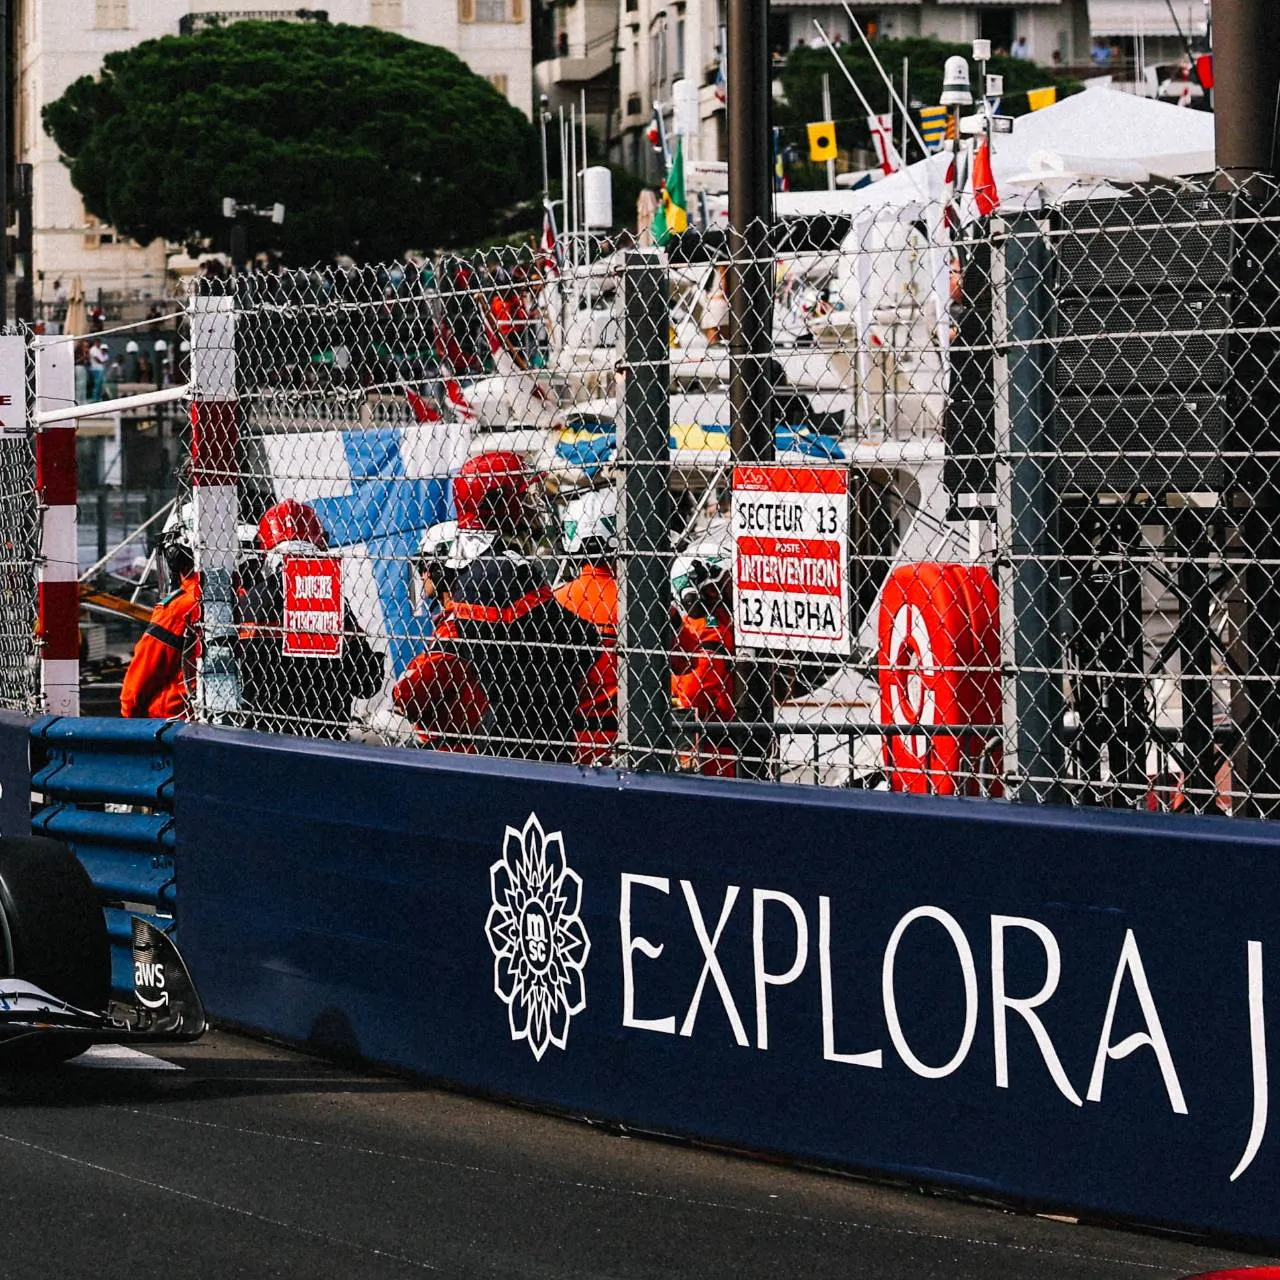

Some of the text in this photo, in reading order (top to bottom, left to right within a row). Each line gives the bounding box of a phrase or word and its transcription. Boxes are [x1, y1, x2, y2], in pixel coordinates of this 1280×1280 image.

[739, 503, 838, 534] SECTEUR 13
[775, 542, 801, 553] POSTE
[740, 554, 839, 588] INTERVENTION
[742, 597, 836, 632] 13 ALPHA
[134, 962, 165, 988] aws
[620, 873, 1188, 1115] EXPLORA
